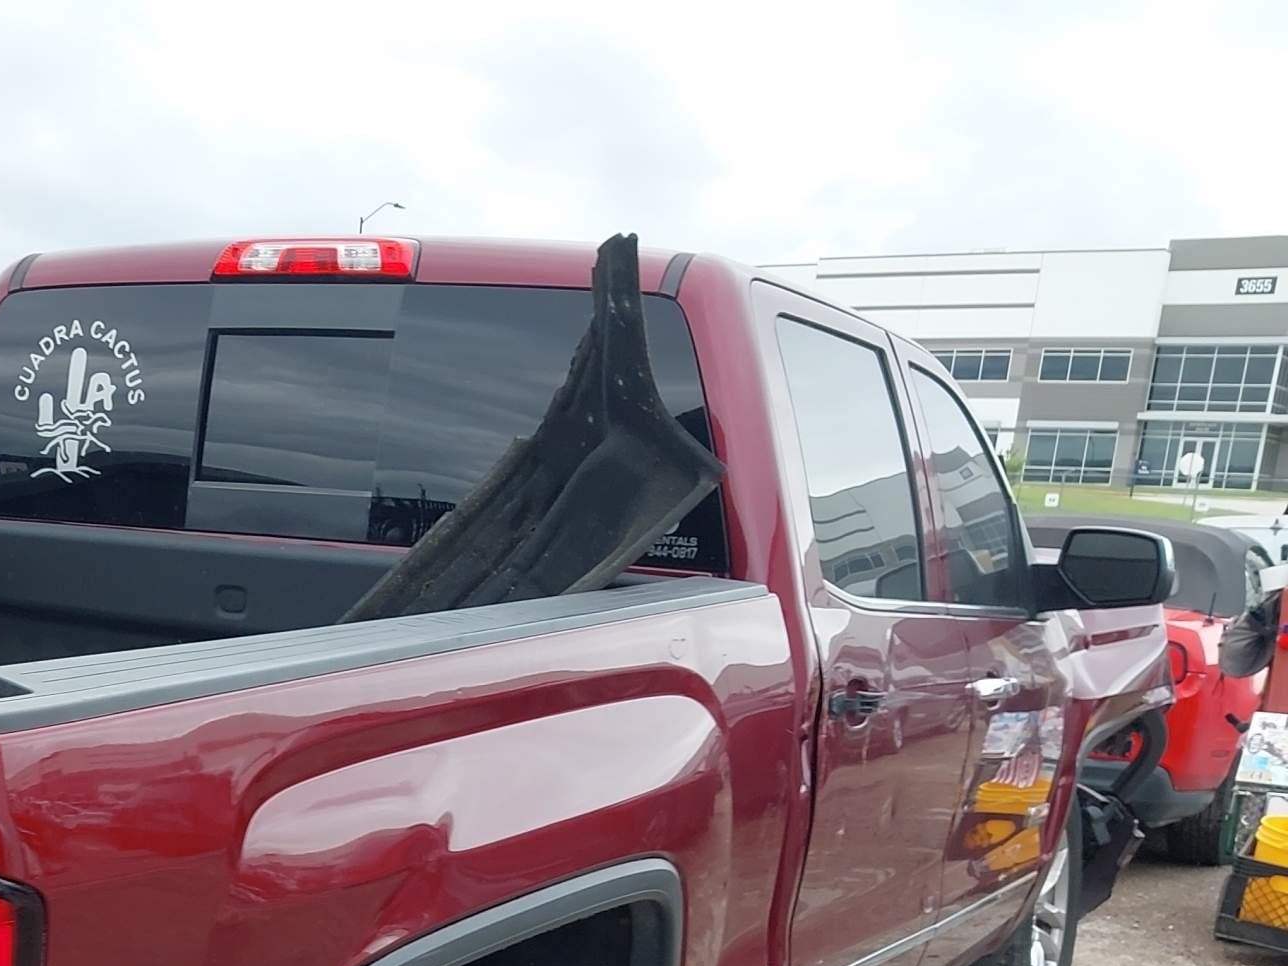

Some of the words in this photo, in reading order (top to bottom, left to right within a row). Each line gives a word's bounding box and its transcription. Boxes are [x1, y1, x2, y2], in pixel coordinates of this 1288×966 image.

[1239, 278, 1273, 294] 3655
[14, 319, 84, 401] CUADRA
[90, 320, 145, 405] CACTUS
